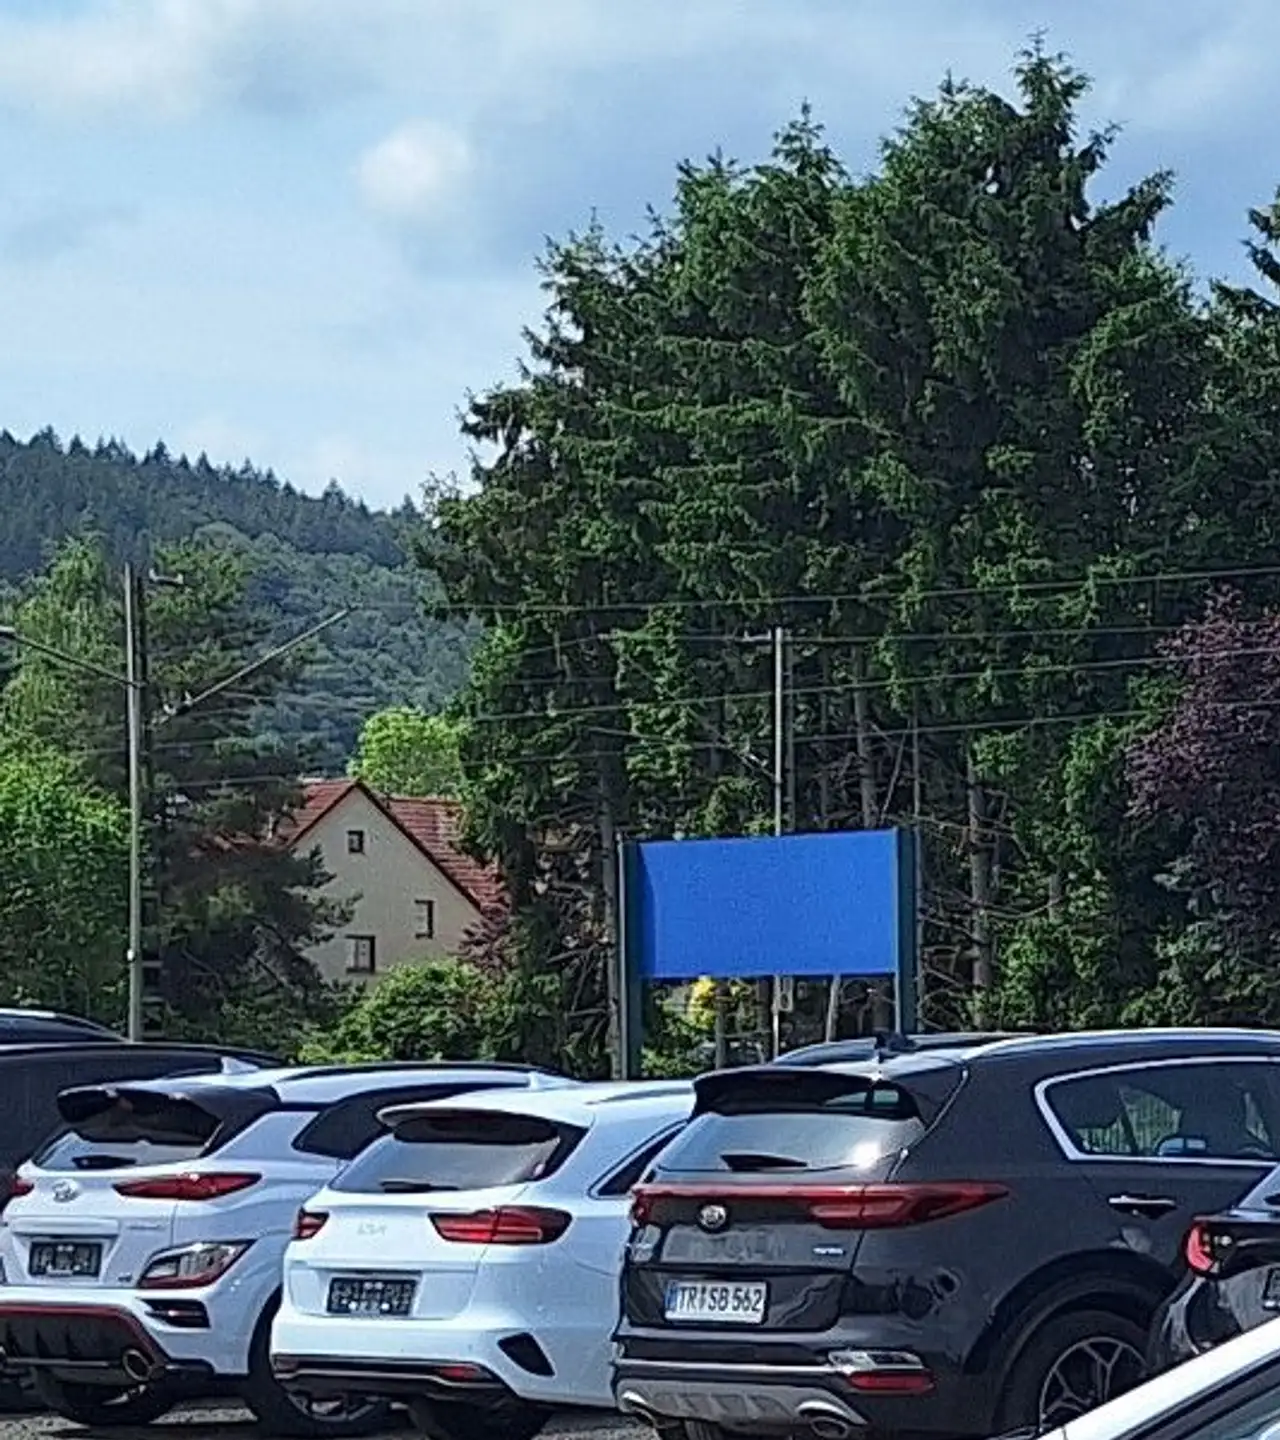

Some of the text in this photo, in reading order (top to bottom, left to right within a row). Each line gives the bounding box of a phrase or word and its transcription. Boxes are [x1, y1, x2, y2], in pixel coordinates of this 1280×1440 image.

[680, 1286, 762, 1312] TR SB 562
